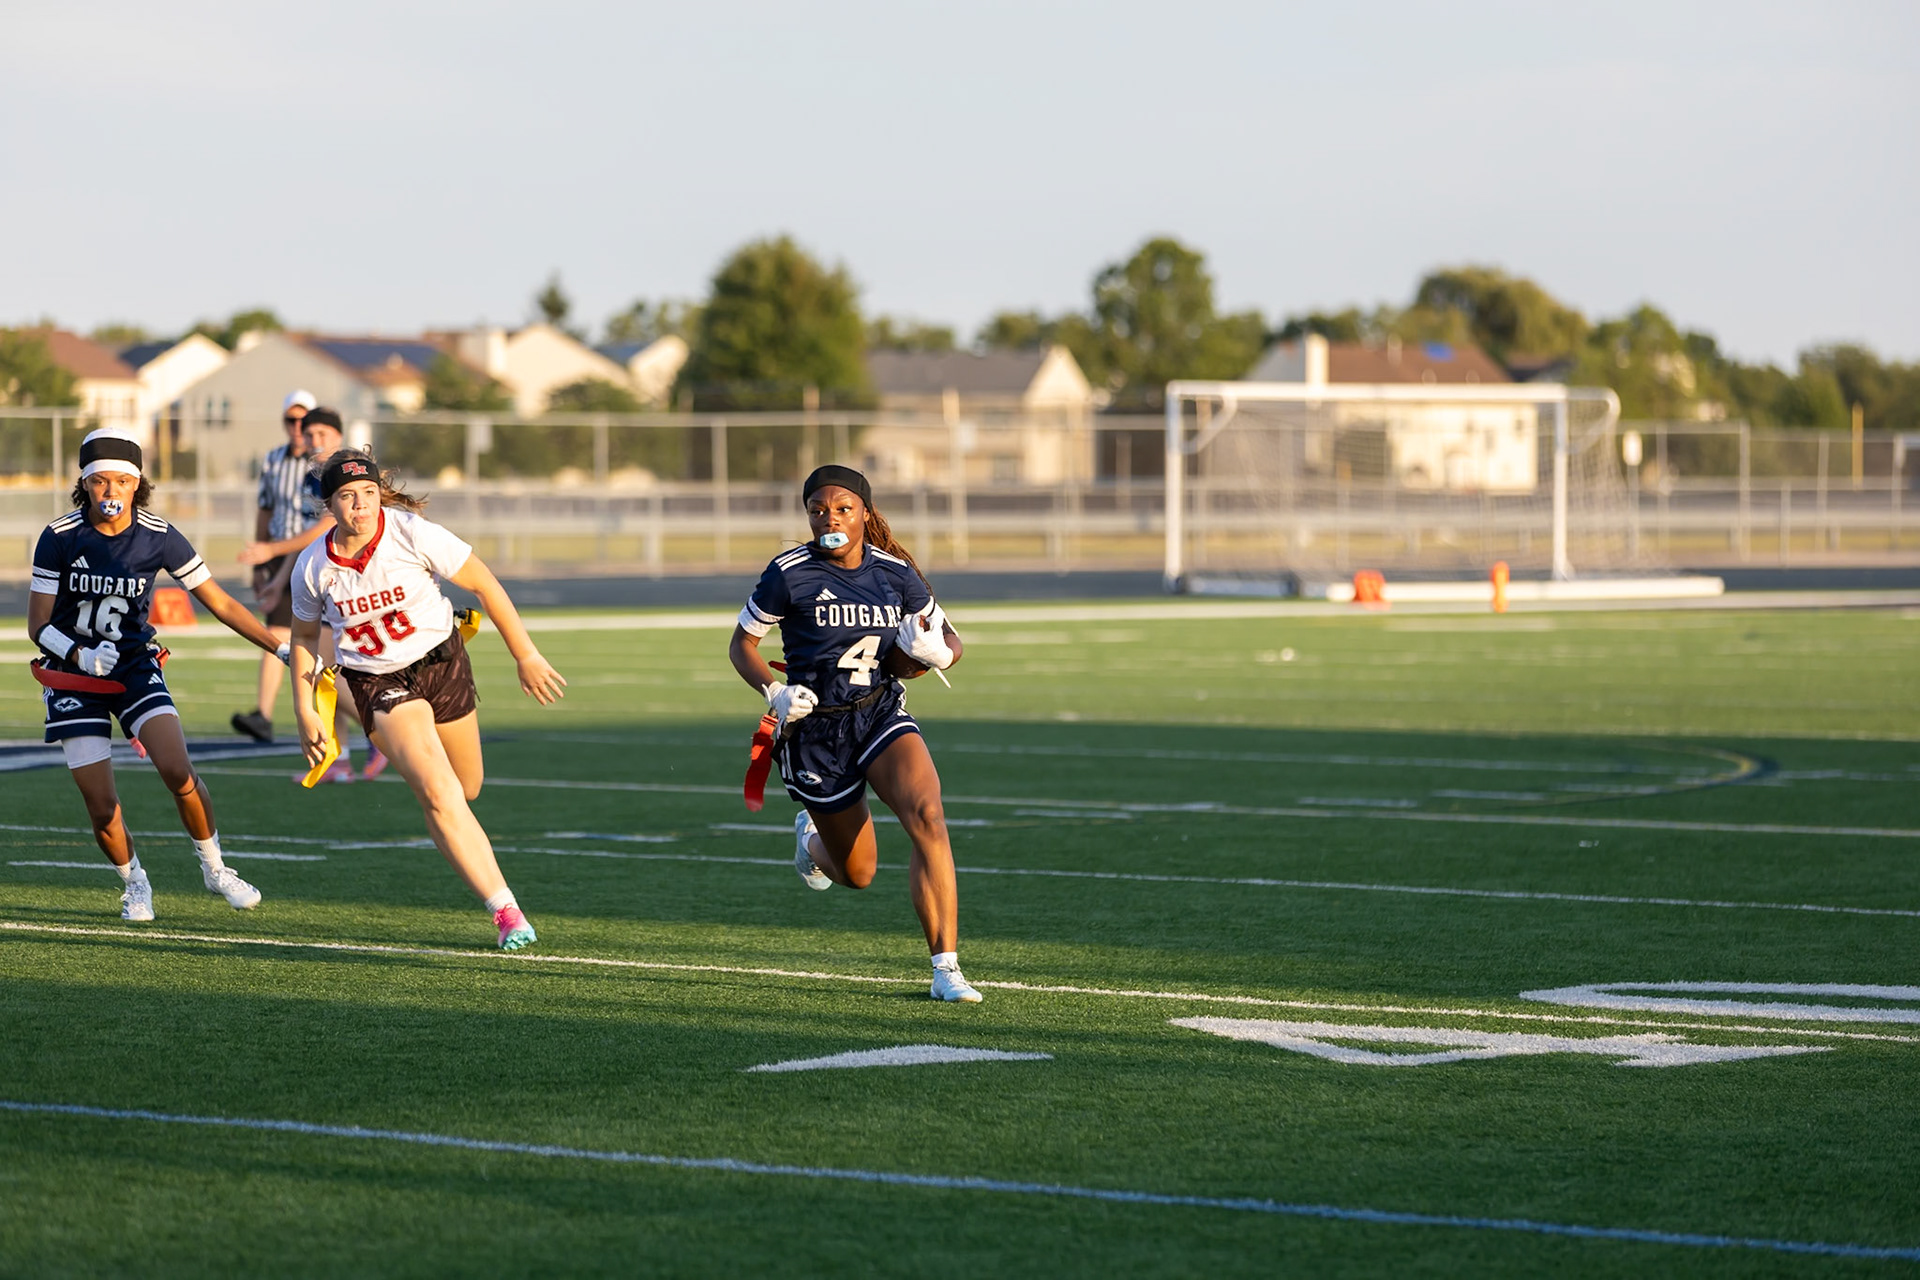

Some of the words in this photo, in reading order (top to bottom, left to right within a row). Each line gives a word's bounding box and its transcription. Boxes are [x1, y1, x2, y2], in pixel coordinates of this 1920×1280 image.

[69, 572, 147, 598] COUGARS
[334, 586, 406, 617] TIGERS
[73, 595, 130, 642] 16
[837, 635, 881, 686] 4
